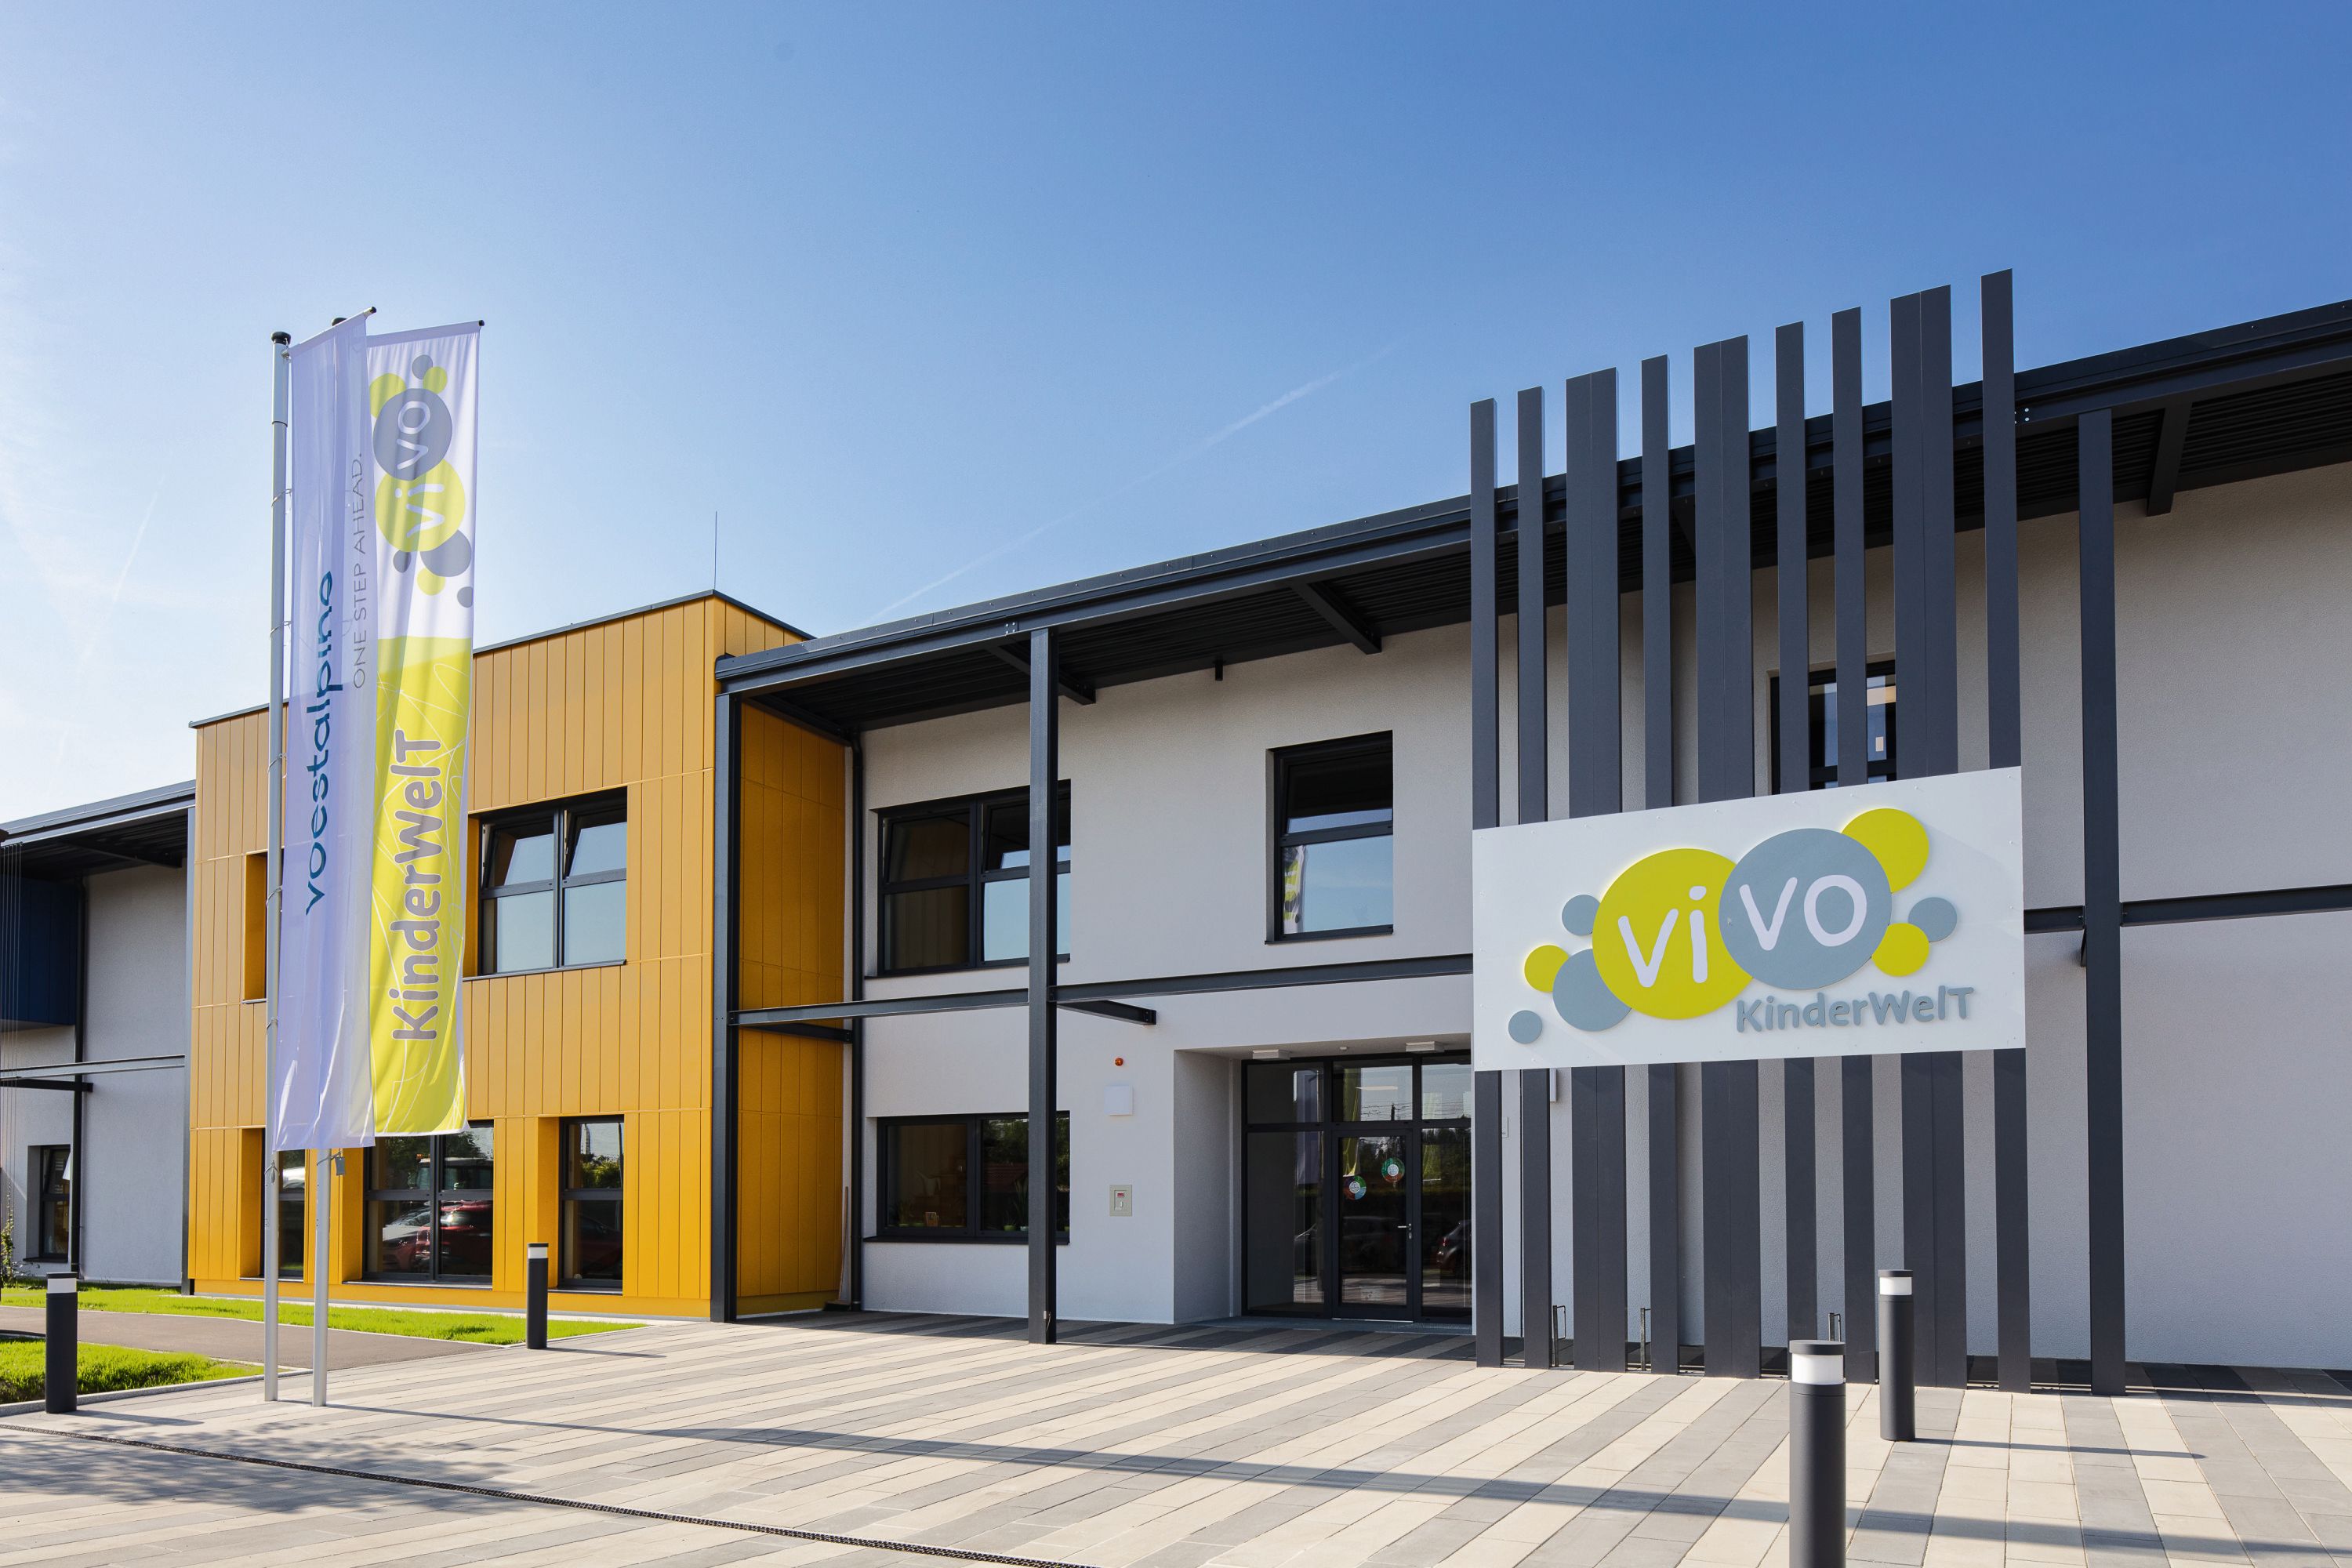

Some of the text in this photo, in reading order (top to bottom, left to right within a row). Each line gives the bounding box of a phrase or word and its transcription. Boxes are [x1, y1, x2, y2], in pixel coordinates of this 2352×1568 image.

[351, 452, 367, 689] ONE STEP AHEAD.
[306, 570, 343, 916] voestalpine
